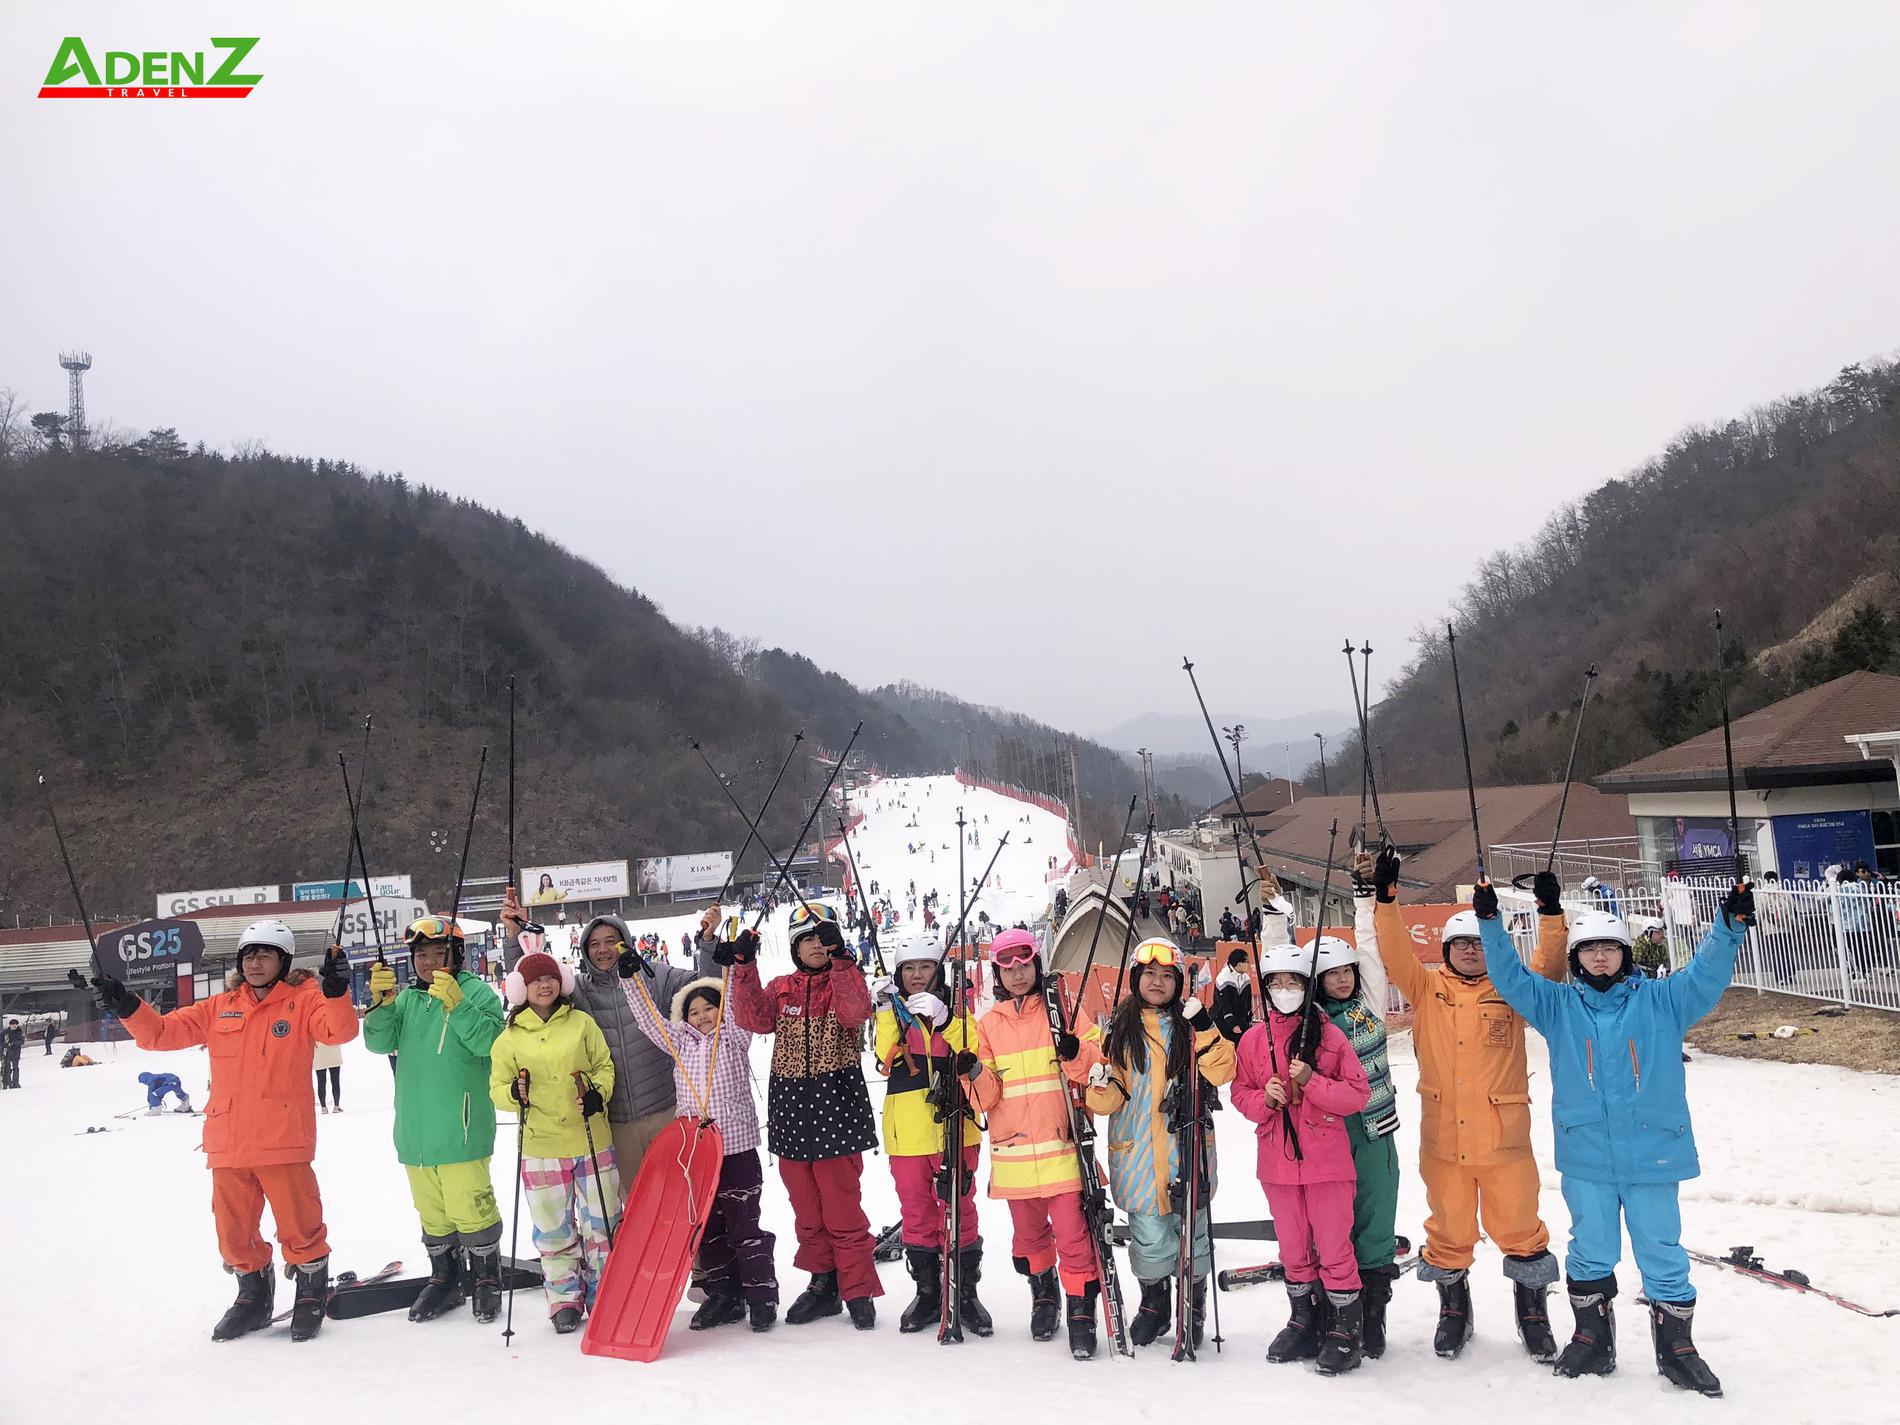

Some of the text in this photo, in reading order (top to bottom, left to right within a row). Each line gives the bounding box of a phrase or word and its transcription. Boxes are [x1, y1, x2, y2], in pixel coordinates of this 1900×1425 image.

[1703, 844, 1722, 858] YMCA
[171, 898, 200, 916] GS
[343, 912, 367, 934] GS
[118, 927, 182, 962] GS25
